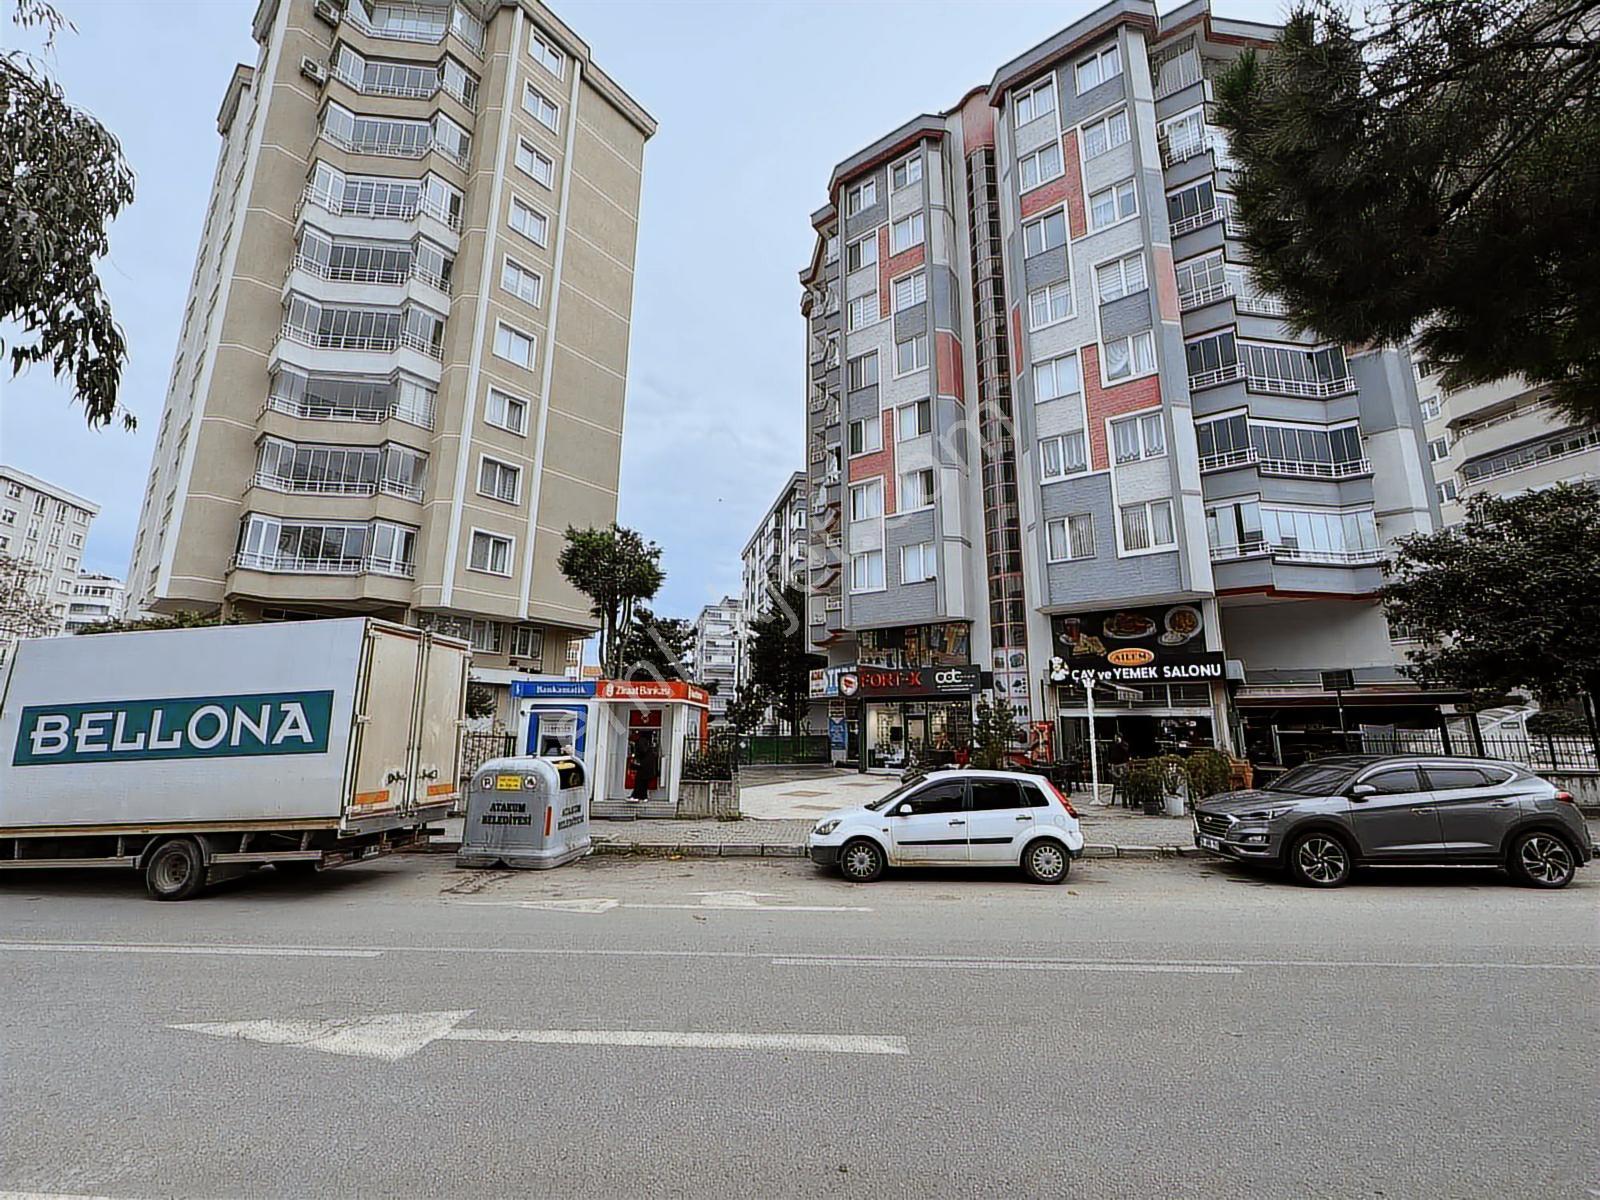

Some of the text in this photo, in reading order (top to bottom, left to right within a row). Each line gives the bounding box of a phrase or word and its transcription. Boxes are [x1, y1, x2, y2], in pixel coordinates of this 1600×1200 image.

[1097, 671, 1112, 680] ve
[1113, 666, 1158, 679] YEMEK
[1163, 663, 1221, 678] SALONU
[30, 702, 314, 755] BELLONA
[489, 803, 526, 812] ATAKUM
